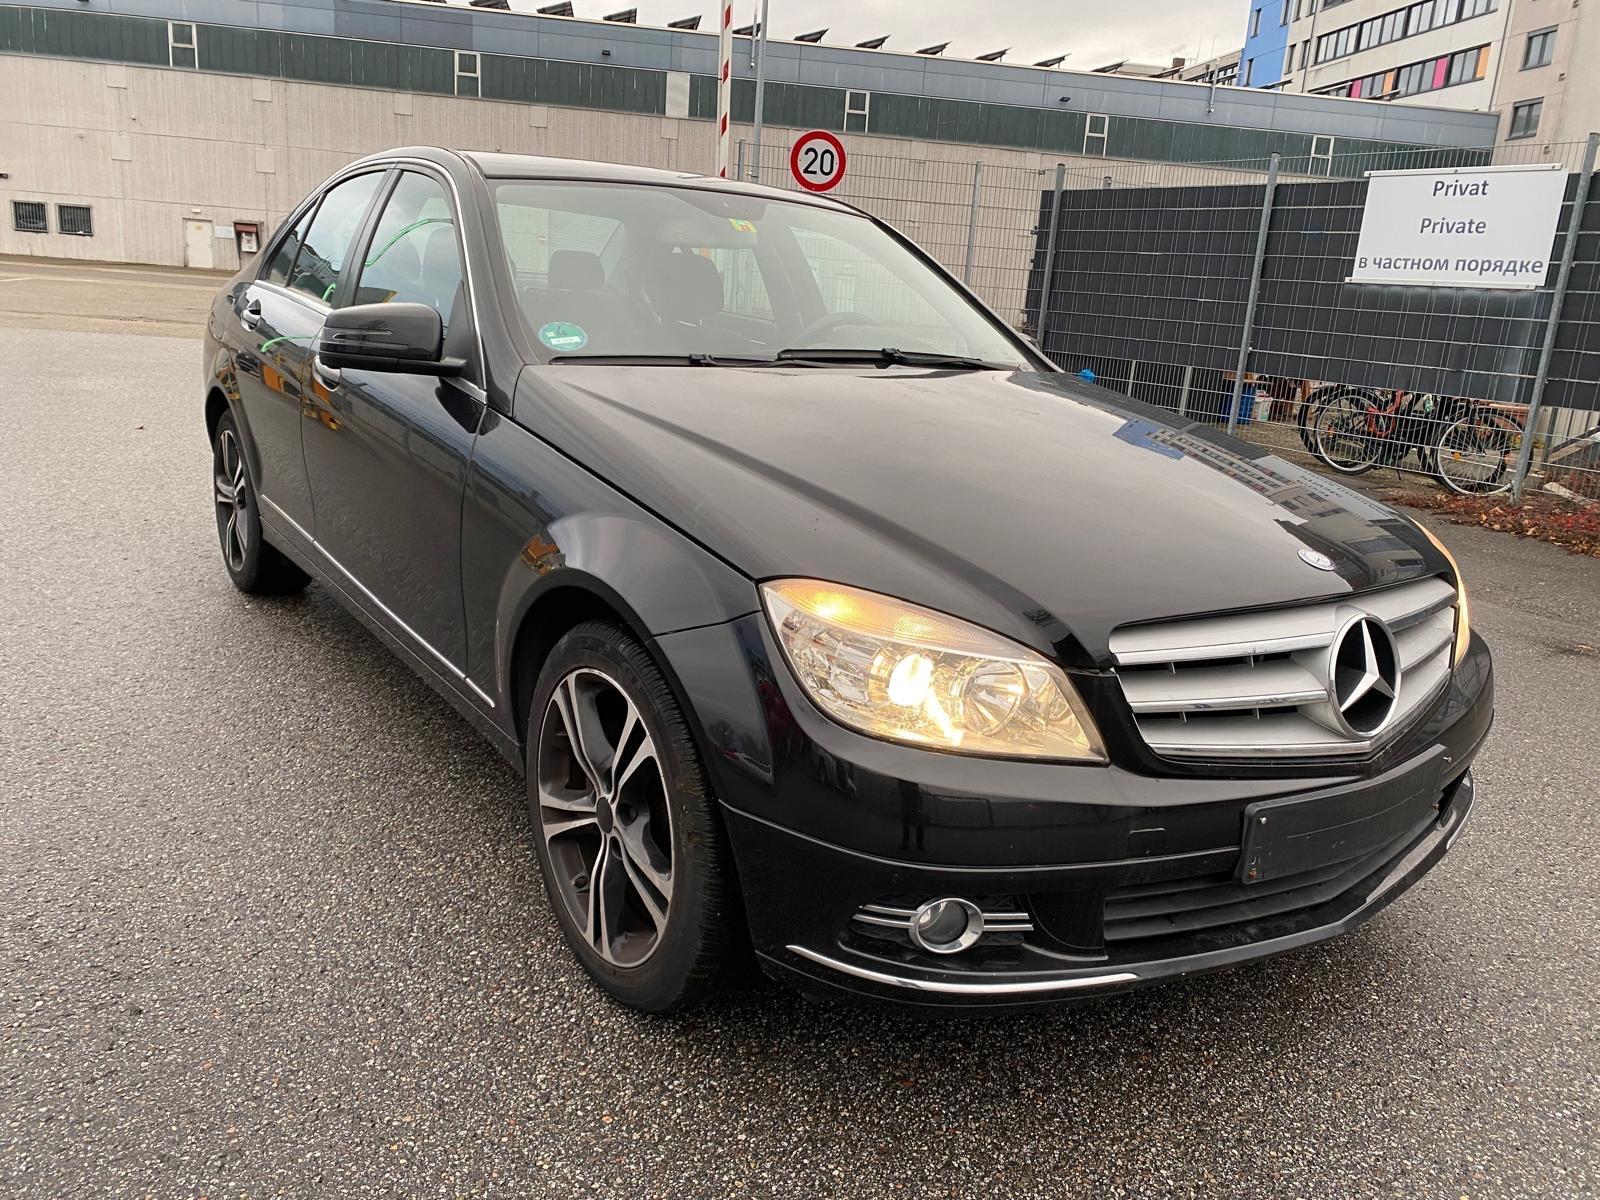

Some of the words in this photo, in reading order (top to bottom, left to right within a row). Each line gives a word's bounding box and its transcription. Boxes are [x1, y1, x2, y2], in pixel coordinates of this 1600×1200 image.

[803, 147, 835, 176] 20
[1432, 179, 1489, 197] Privat
[1420, 217, 1487, 234] Private
[1358, 257, 1368, 269] в
[1372, 257, 1449, 271] частном
[1454, 258, 1544, 276] порядке
